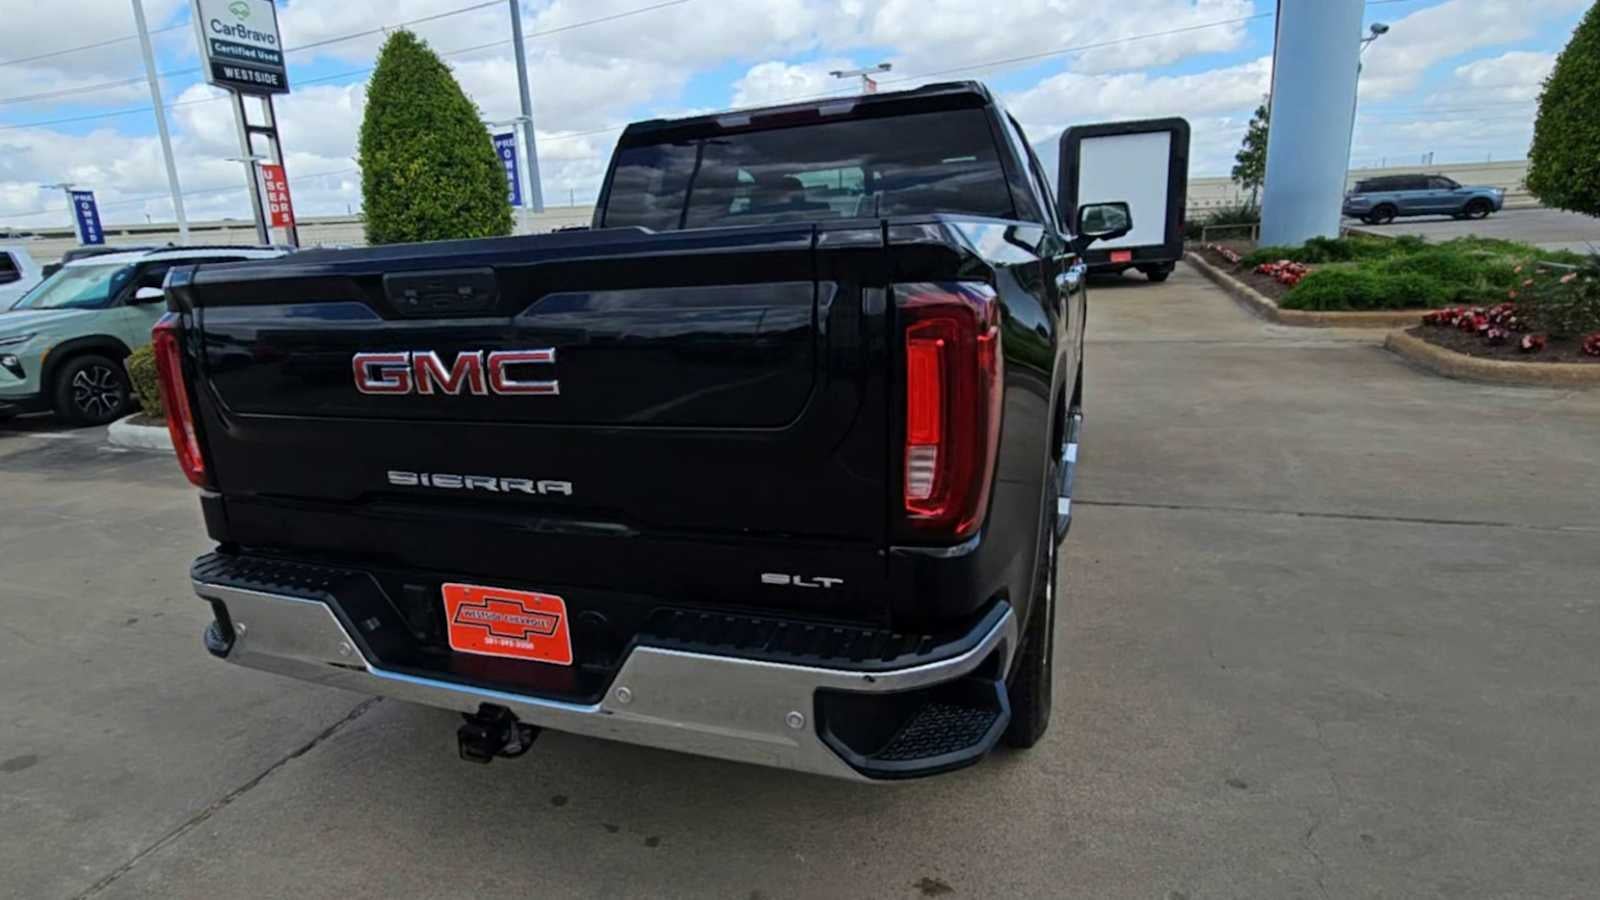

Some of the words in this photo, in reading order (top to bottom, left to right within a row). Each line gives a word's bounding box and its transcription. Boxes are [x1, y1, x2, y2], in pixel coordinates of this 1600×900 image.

[210, 18, 276, 45] CarBravo
[214, 42, 256, 58] Certified
[257, 49, 279, 62] Used
[223, 66, 279, 85] WESTSIDE
[263, 169, 280, 213] USED
[276, 181, 290, 223] CARS
[81, 201, 98, 242] OWNED
[352, 348, 560, 396] GMC
[387, 470, 573, 496] SIERRA
[760, 572, 844, 589] SLT
